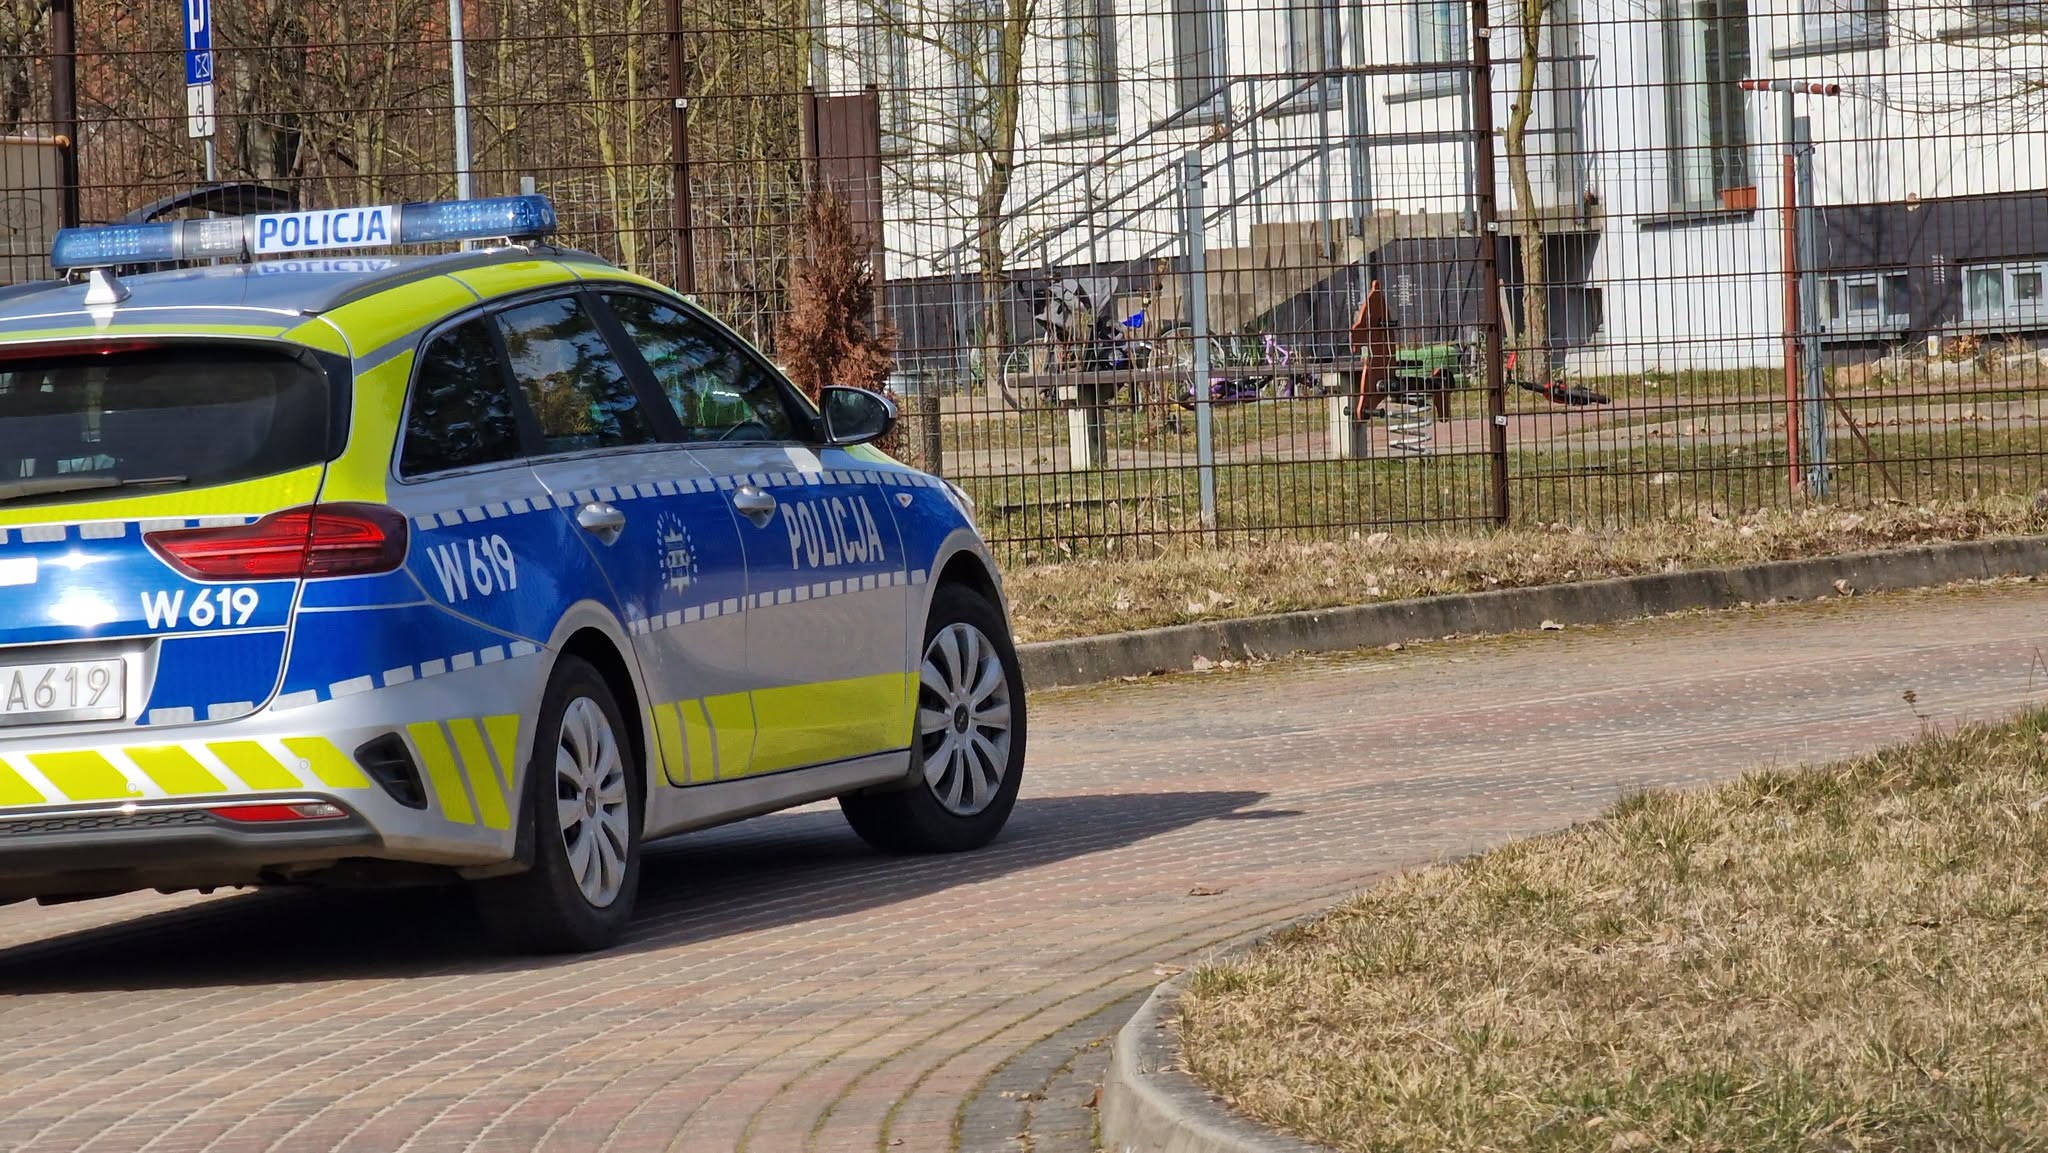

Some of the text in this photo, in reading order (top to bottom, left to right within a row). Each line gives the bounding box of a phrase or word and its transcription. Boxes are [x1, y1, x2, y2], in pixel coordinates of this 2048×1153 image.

[188, 0, 205, 50] P
[259, 210, 387, 248] POLICJA
[780, 495, 885, 570] POLICJA
[6, 665, 110, 711] A619
